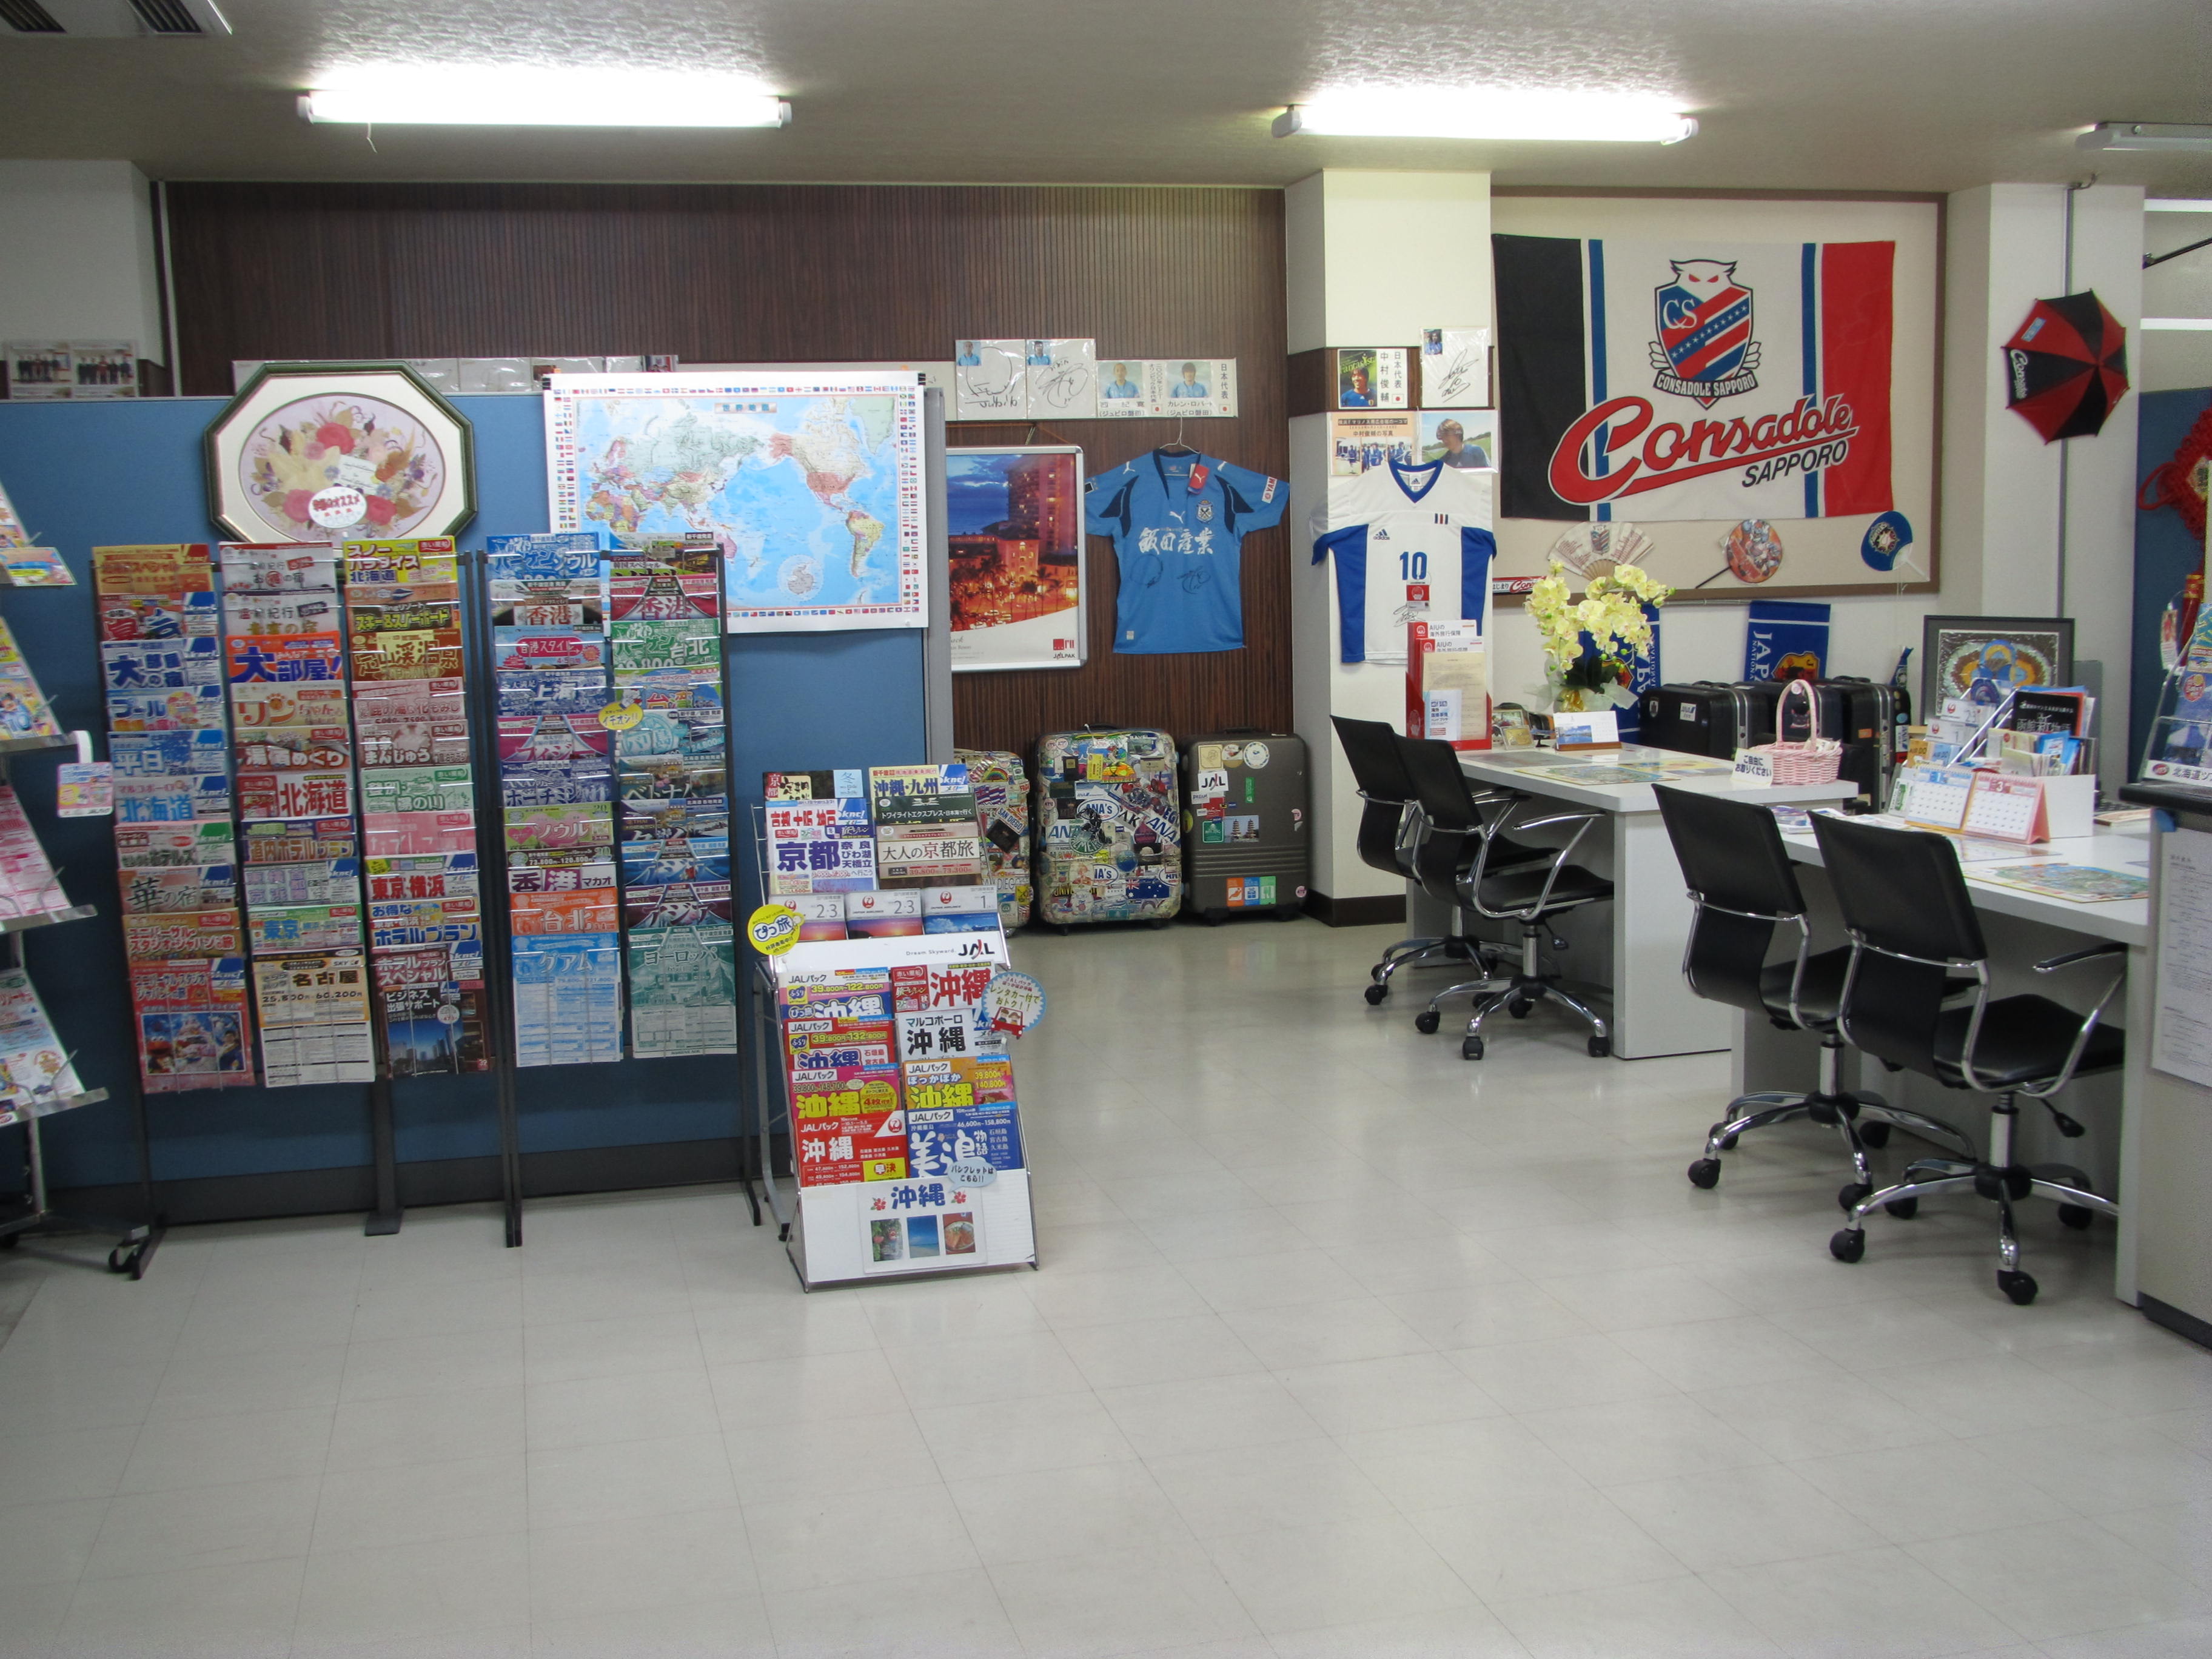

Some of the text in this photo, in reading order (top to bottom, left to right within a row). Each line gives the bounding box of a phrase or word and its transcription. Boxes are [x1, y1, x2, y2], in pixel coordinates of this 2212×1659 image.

[1220, 363, 1229, 400] 日本代表
[1655, 374, 1756, 397] CONSADOLE SAPPORO
[722, 403, 771, 412] 世界地図
[1548, 394, 1854, 506] Consadole
[1741, 439, 1849, 489] SAPPORO
[347, 545, 392, 557] スノー
[1399, 551, 1427, 580] 10
[350, 569, 395, 582] 北海道
[526, 605, 572, 626] 香港
[670, 638, 711, 659] 台北
[537, 682, 577, 702] 上海
[113, 749, 163, 775] 平日
[365, 748, 431, 765] まんじゅう
[1743, 754, 1764, 766] ご自由に
[840, 772, 856, 784] 冬
[1734, 762, 1772, 777] お取りください
[873, 777, 939, 797] 沖縄・九州
[1201, 773, 1225, 790] JAL
[1995, 780, 2005, 792] 3
[121, 794, 193, 822] 北海道
[280, 780, 349, 817] 北海道
[534, 821, 589, 840] ソウル
[1007, 814, 1024, 831] DIEGO
[840, 840, 871, 850] 奈良
[842, 850, 872, 859] びわ湖
[882, 840, 974, 862] 大人の京都旅
[776, 840, 841, 872] 京都
[842, 859, 873, 868] 天橋立
[511, 870, 578, 893] 香港
[581, 876, 612, 886] マカオ
[126, 877, 198, 914] 華の宿
[541, 910, 593, 933] 台北
[643, 947, 719, 966] ヨーロッパ
[928, 948, 957, 957] Skyward.
[958, 939, 995, 960] JAL
[378, 956, 421, 970] ホテル
[538, 951, 594, 973] グアム
[292, 970, 360, 988] 名古屋
[380, 970, 447, 987] スペシャル
[788, 974, 827, 984] JALパック
[930, 968, 992, 1008] 沖縄
[386, 990, 431, 1002] ビジネス
[990, 985, 1041, 1004] レンタカー付で
[791, 1022, 830, 1032] JALパック
[906, 1014, 963, 1028] マルコポーロ
[907, 1026, 966, 1056] 沖縄
[795, 1070, 835, 1081] JALパック
[909, 1062, 948, 1074] JALパック
[796, 1091, 861, 1119] 沖縄
[910, 1082, 974, 1109] 沖縄
[911, 1111, 951, 1122] JALパック
[800, 1122, 839, 1133] JALパック
[802, 1135, 854, 1164] 沖縄
[951, 1164, 994, 1176] パンフレットは
[890, 1182, 947, 1211] 沖縄
